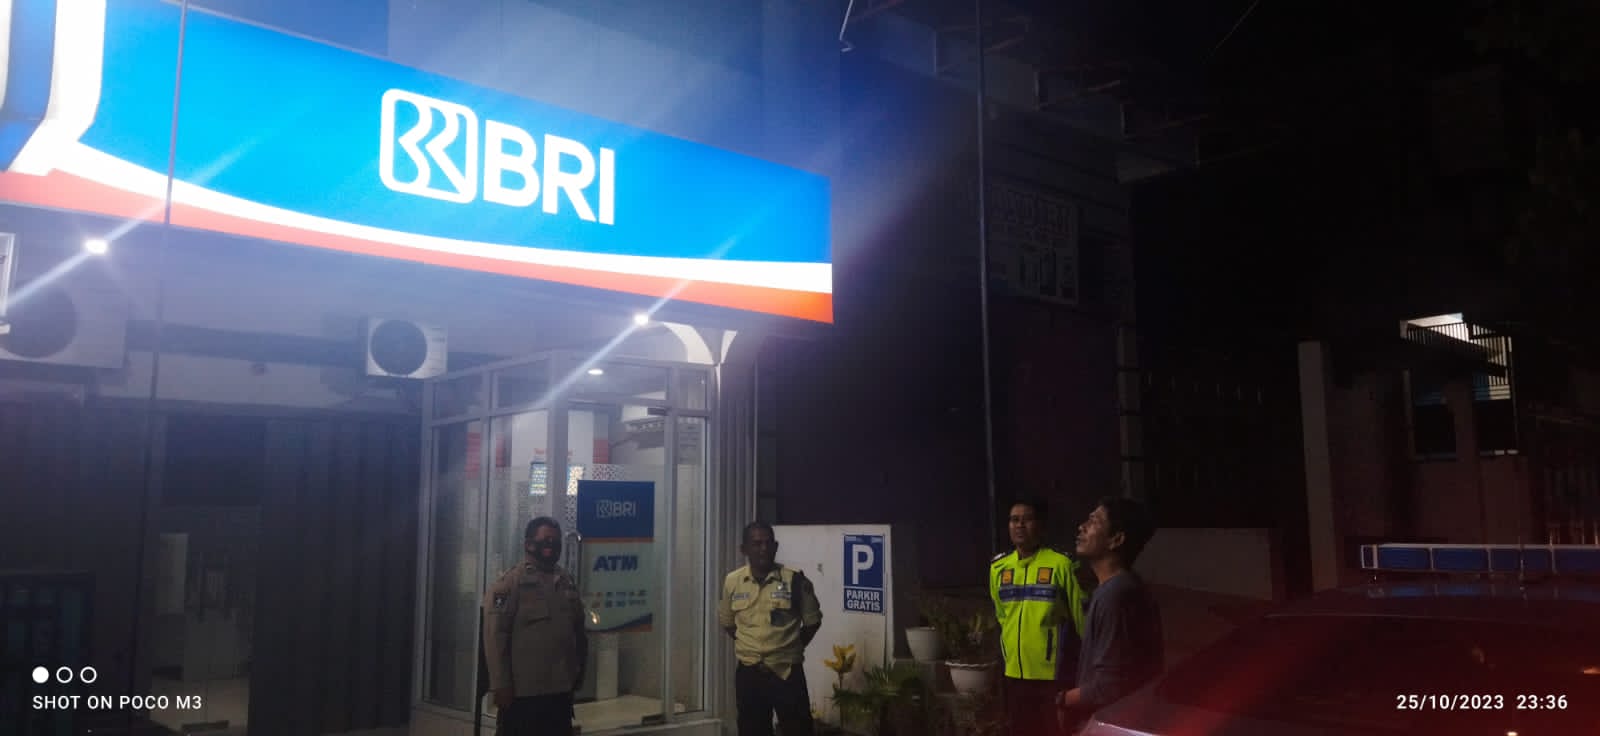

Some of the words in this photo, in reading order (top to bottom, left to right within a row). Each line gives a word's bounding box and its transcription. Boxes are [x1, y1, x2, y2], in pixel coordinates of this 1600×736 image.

[484, 120, 615, 225] BRI
[612, 501, 637, 518] BRI
[593, 555, 638, 572] ATM
[851, 543, 874, 585] P
[846, 589, 880, 602] PARKIR
[846, 599, 881, 612] GRATIS
